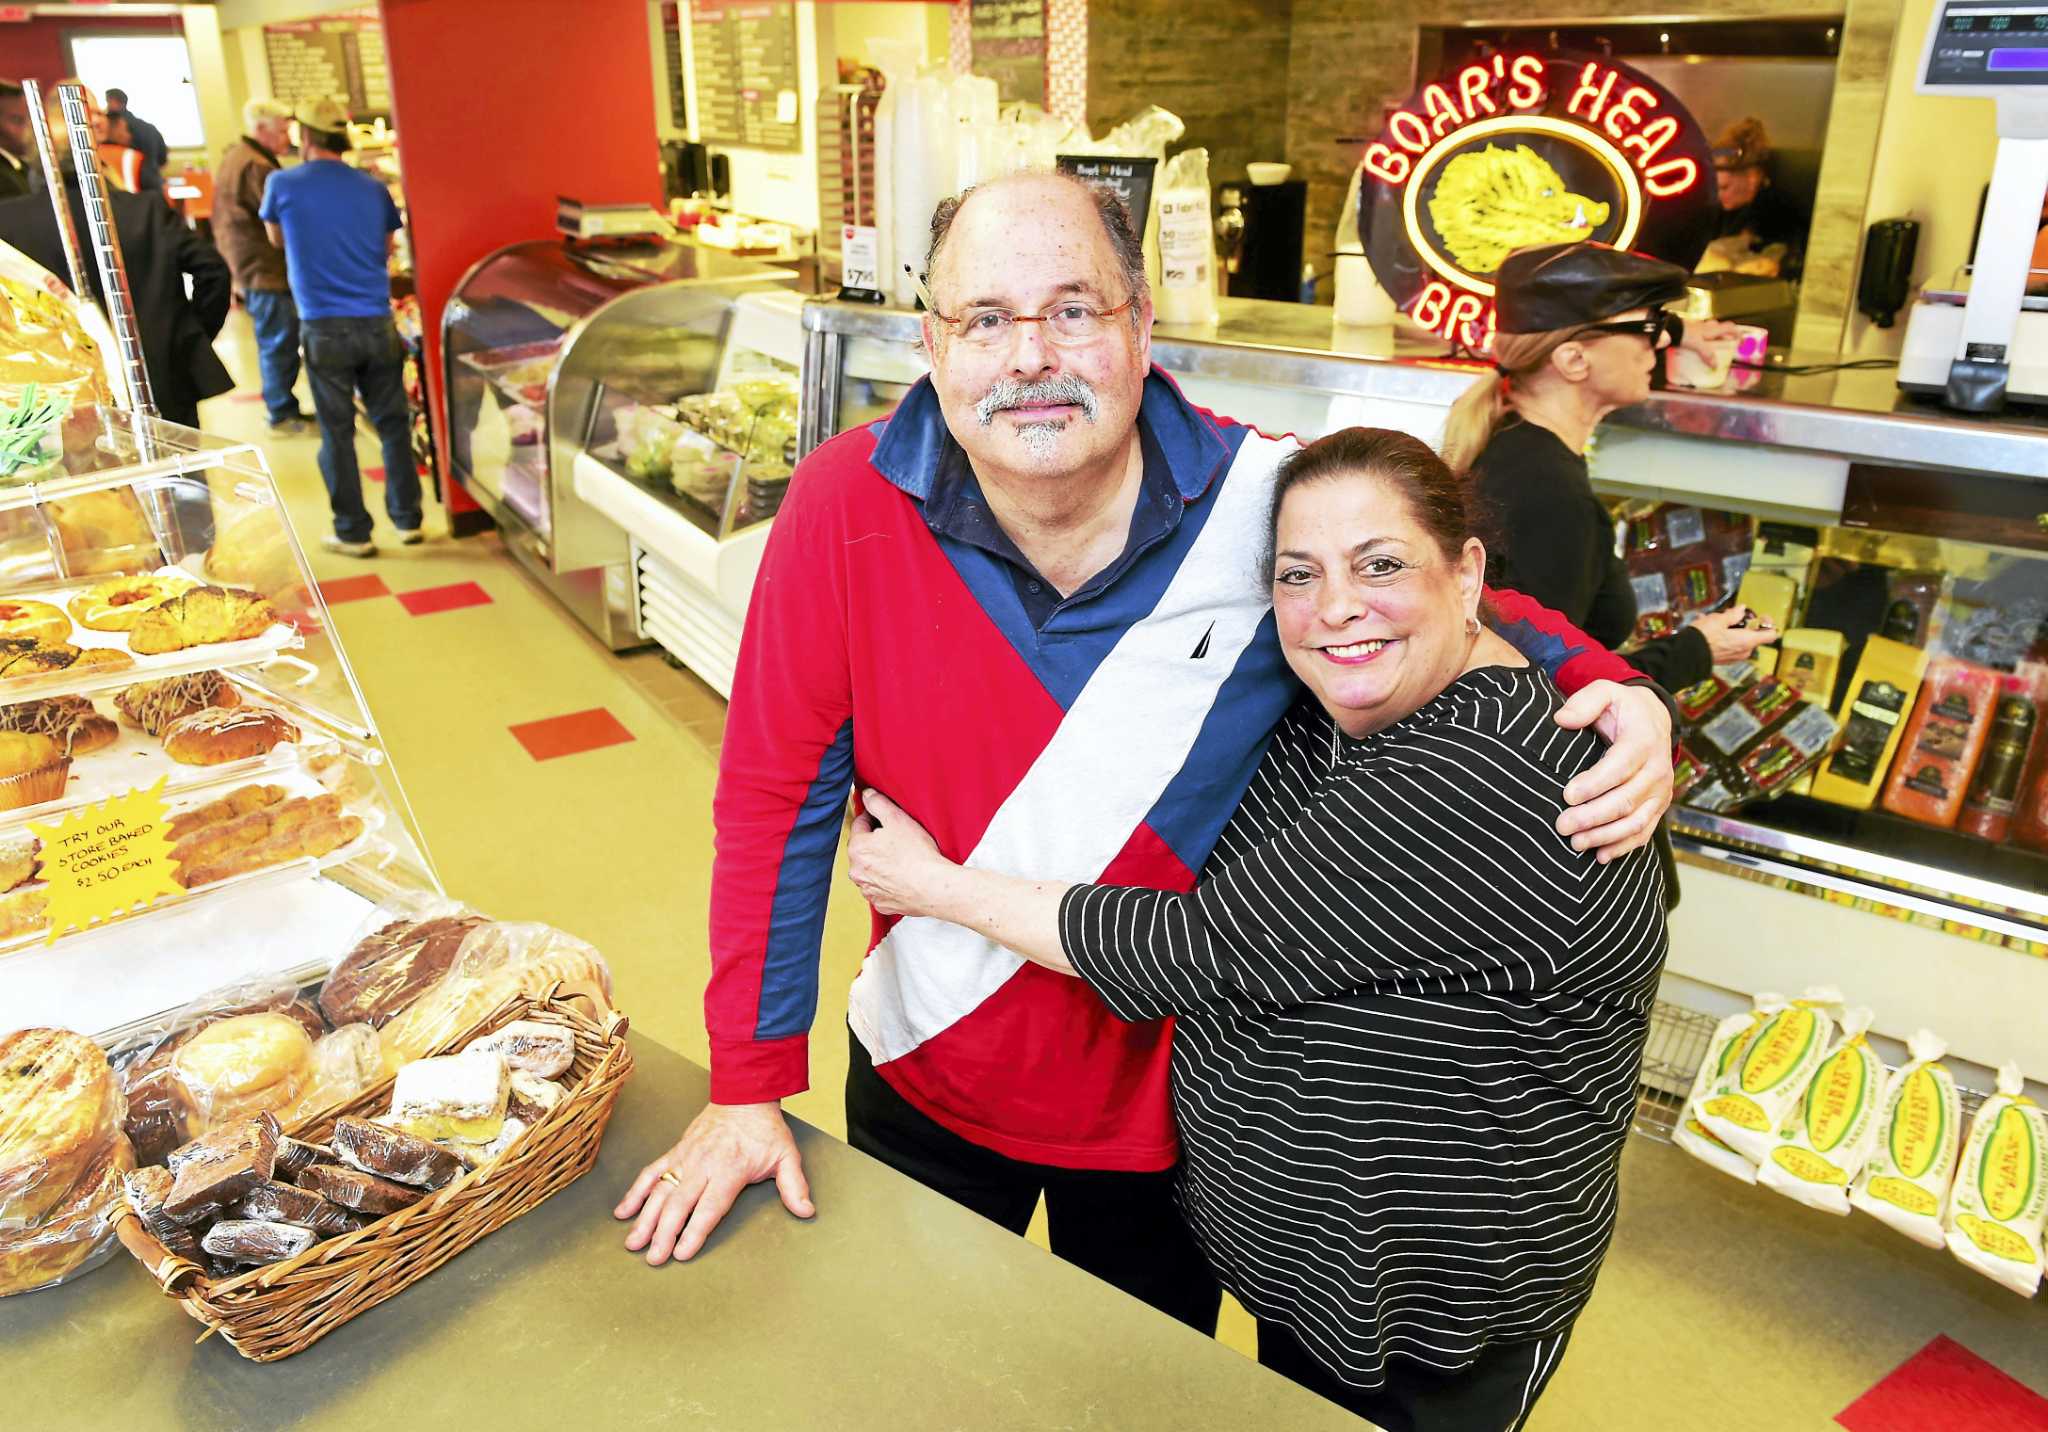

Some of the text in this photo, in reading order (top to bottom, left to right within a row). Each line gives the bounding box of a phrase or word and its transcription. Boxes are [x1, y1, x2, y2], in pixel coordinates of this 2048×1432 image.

[1363, 55, 1697, 197] BOAR'S HEAD
[56, 818, 126, 848] TRY OUR
[58, 824, 154, 868] STORE BAKED
[71, 845, 129, 873] COOKIES
